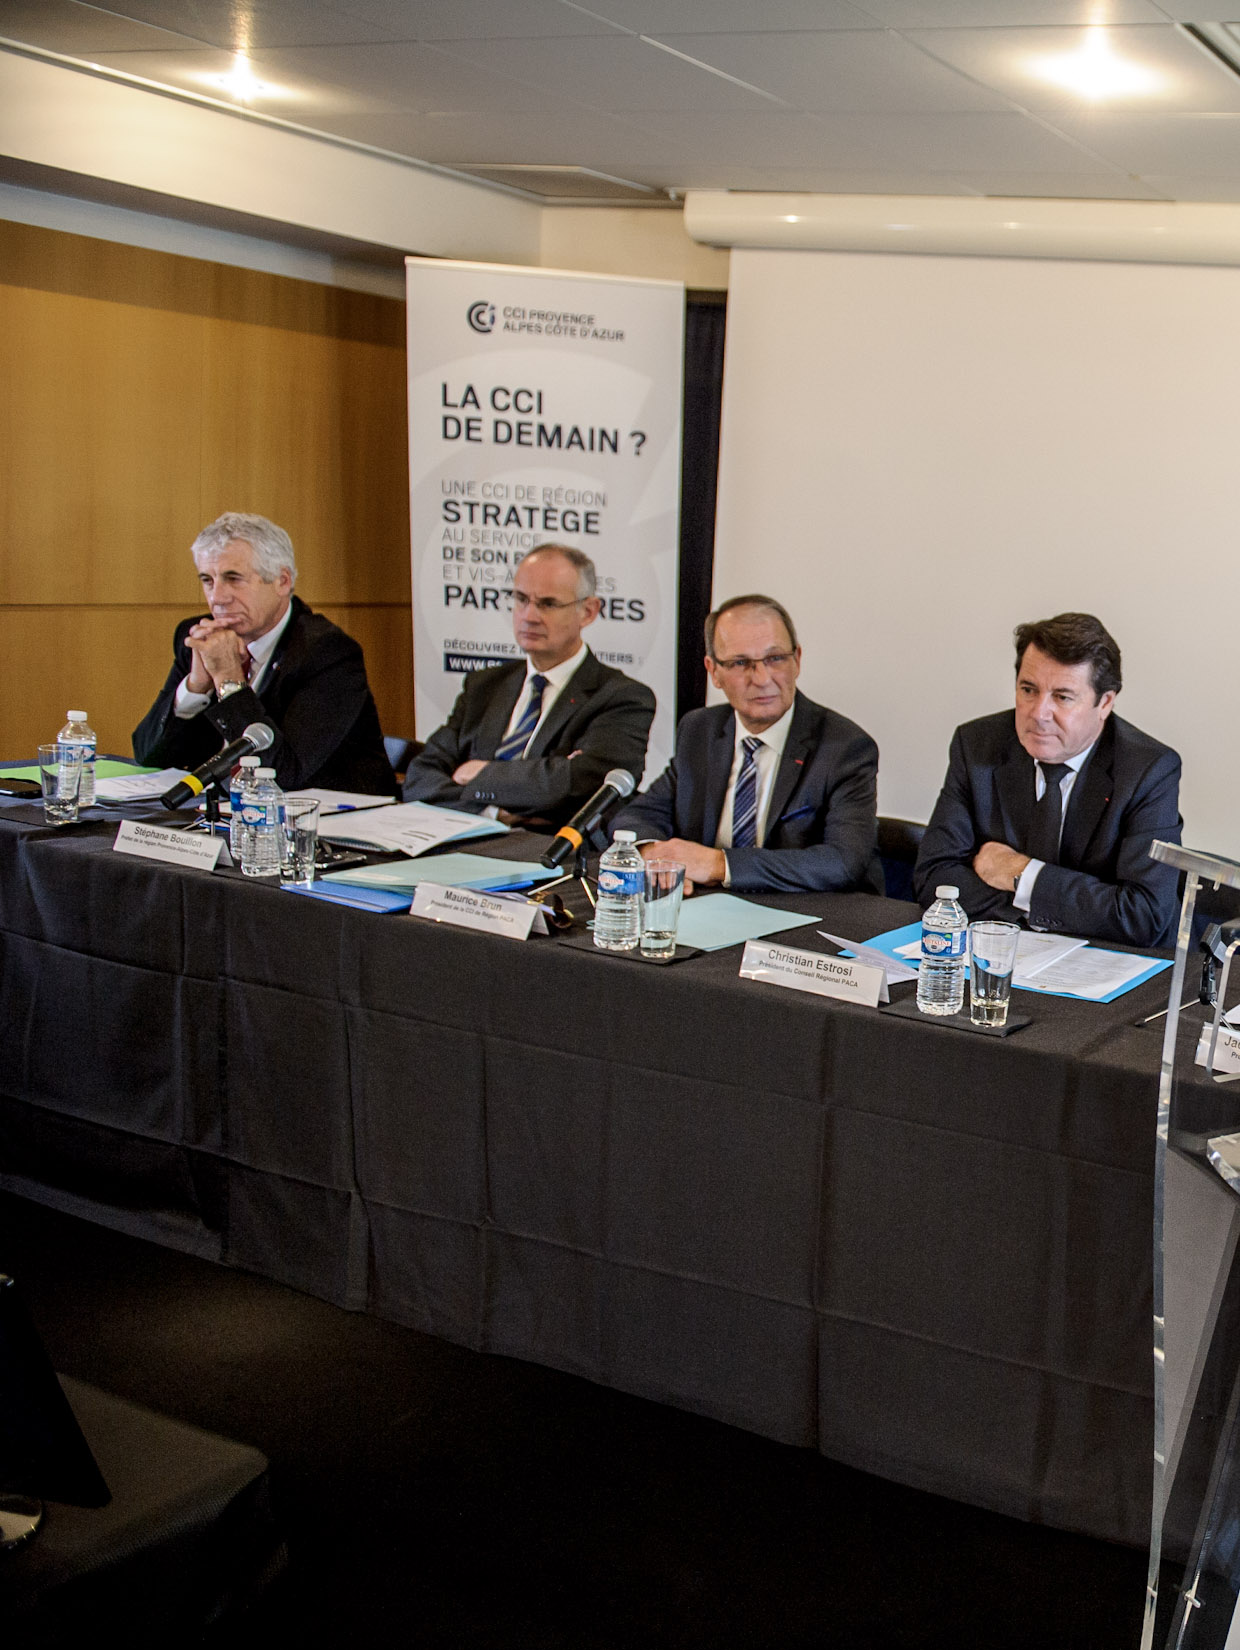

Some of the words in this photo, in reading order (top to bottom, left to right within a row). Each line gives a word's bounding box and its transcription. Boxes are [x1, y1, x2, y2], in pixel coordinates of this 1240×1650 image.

[503, 306, 526, 320] CCI
[529, 309, 595, 325] PROVENCE
[503, 321, 542, 335] ALPES
[580, 327, 625, 342] D'AZUR
[441, 382, 480, 410] LA
[490, 387, 543, 415] CCI
[442, 415, 482, 443] DE
[493, 420, 619, 453] DEMAIN
[630, 431, 647, 456] ?
[441, 479, 475, 497] UNE
[481, 482, 509, 499] CCI
[515, 485, 537, 502] DE
[542, 483, 607, 507] RÉGION
[442, 500, 600, 535] STRATÈGE
[441, 528, 464, 544] AU
[442, 546, 465, 562] DE
[470, 548, 508, 565] SON
[443, 564, 464, 581] ET
[444, 638, 516, 655] DÉCOUVREZ
[134, 826, 169, 842] Stéphane
[170, 834, 203, 849] Bouillon
[444, 890, 479, 906] Maurice
[480, 898, 503, 912] Brun
[768, 949, 814, 968] Christian
[816, 960, 854, 976] Estrosi
[759, 960, 785, 972] Président
[785, 965, 793, 973] du
[793, 967, 815, 978] Conseil
[816, 971, 841, 984] Régional
[841, 978, 859, 988] PACA
